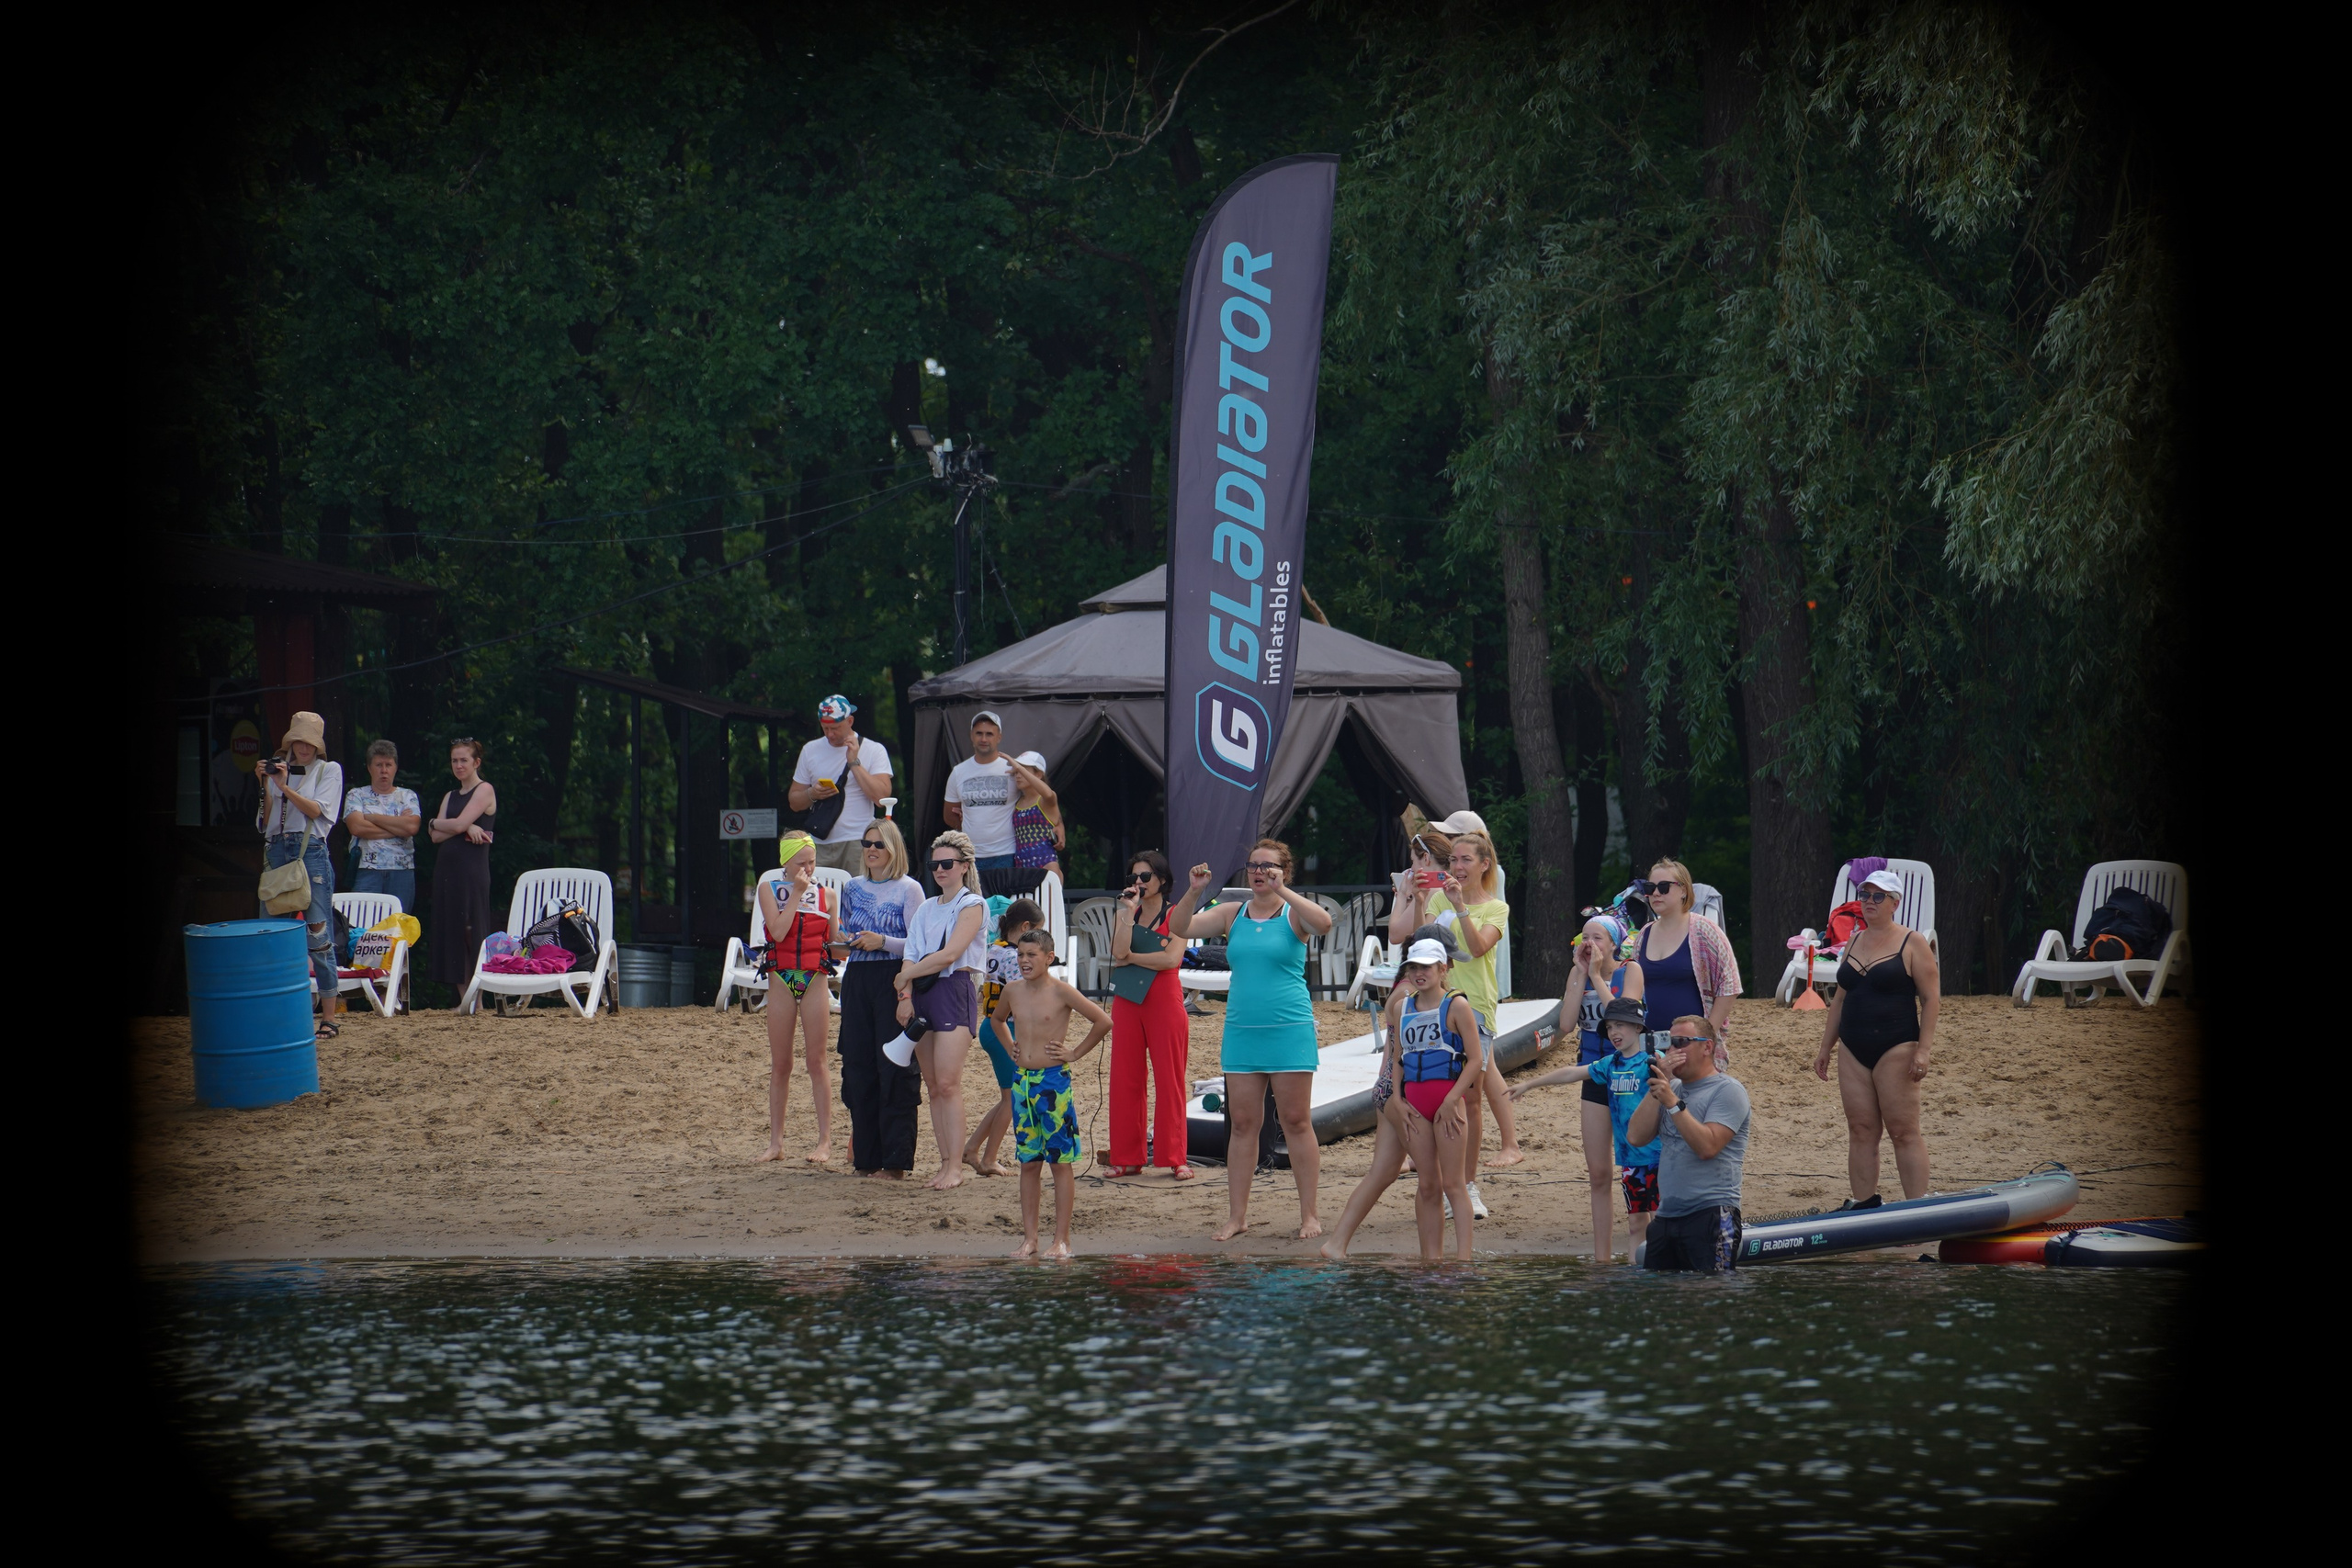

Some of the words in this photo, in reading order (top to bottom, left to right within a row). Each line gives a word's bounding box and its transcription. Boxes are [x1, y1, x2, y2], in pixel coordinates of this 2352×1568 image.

[1262, 560, 1291, 685] inflatables
[234, 740, 257, 752] Lipton
[962, 789, 1008, 800] STRONG
[776, 887, 816, 905] 02
[1405, 1022, 1441, 1044] 073
[1618, 1073, 1640, 1092] limits
